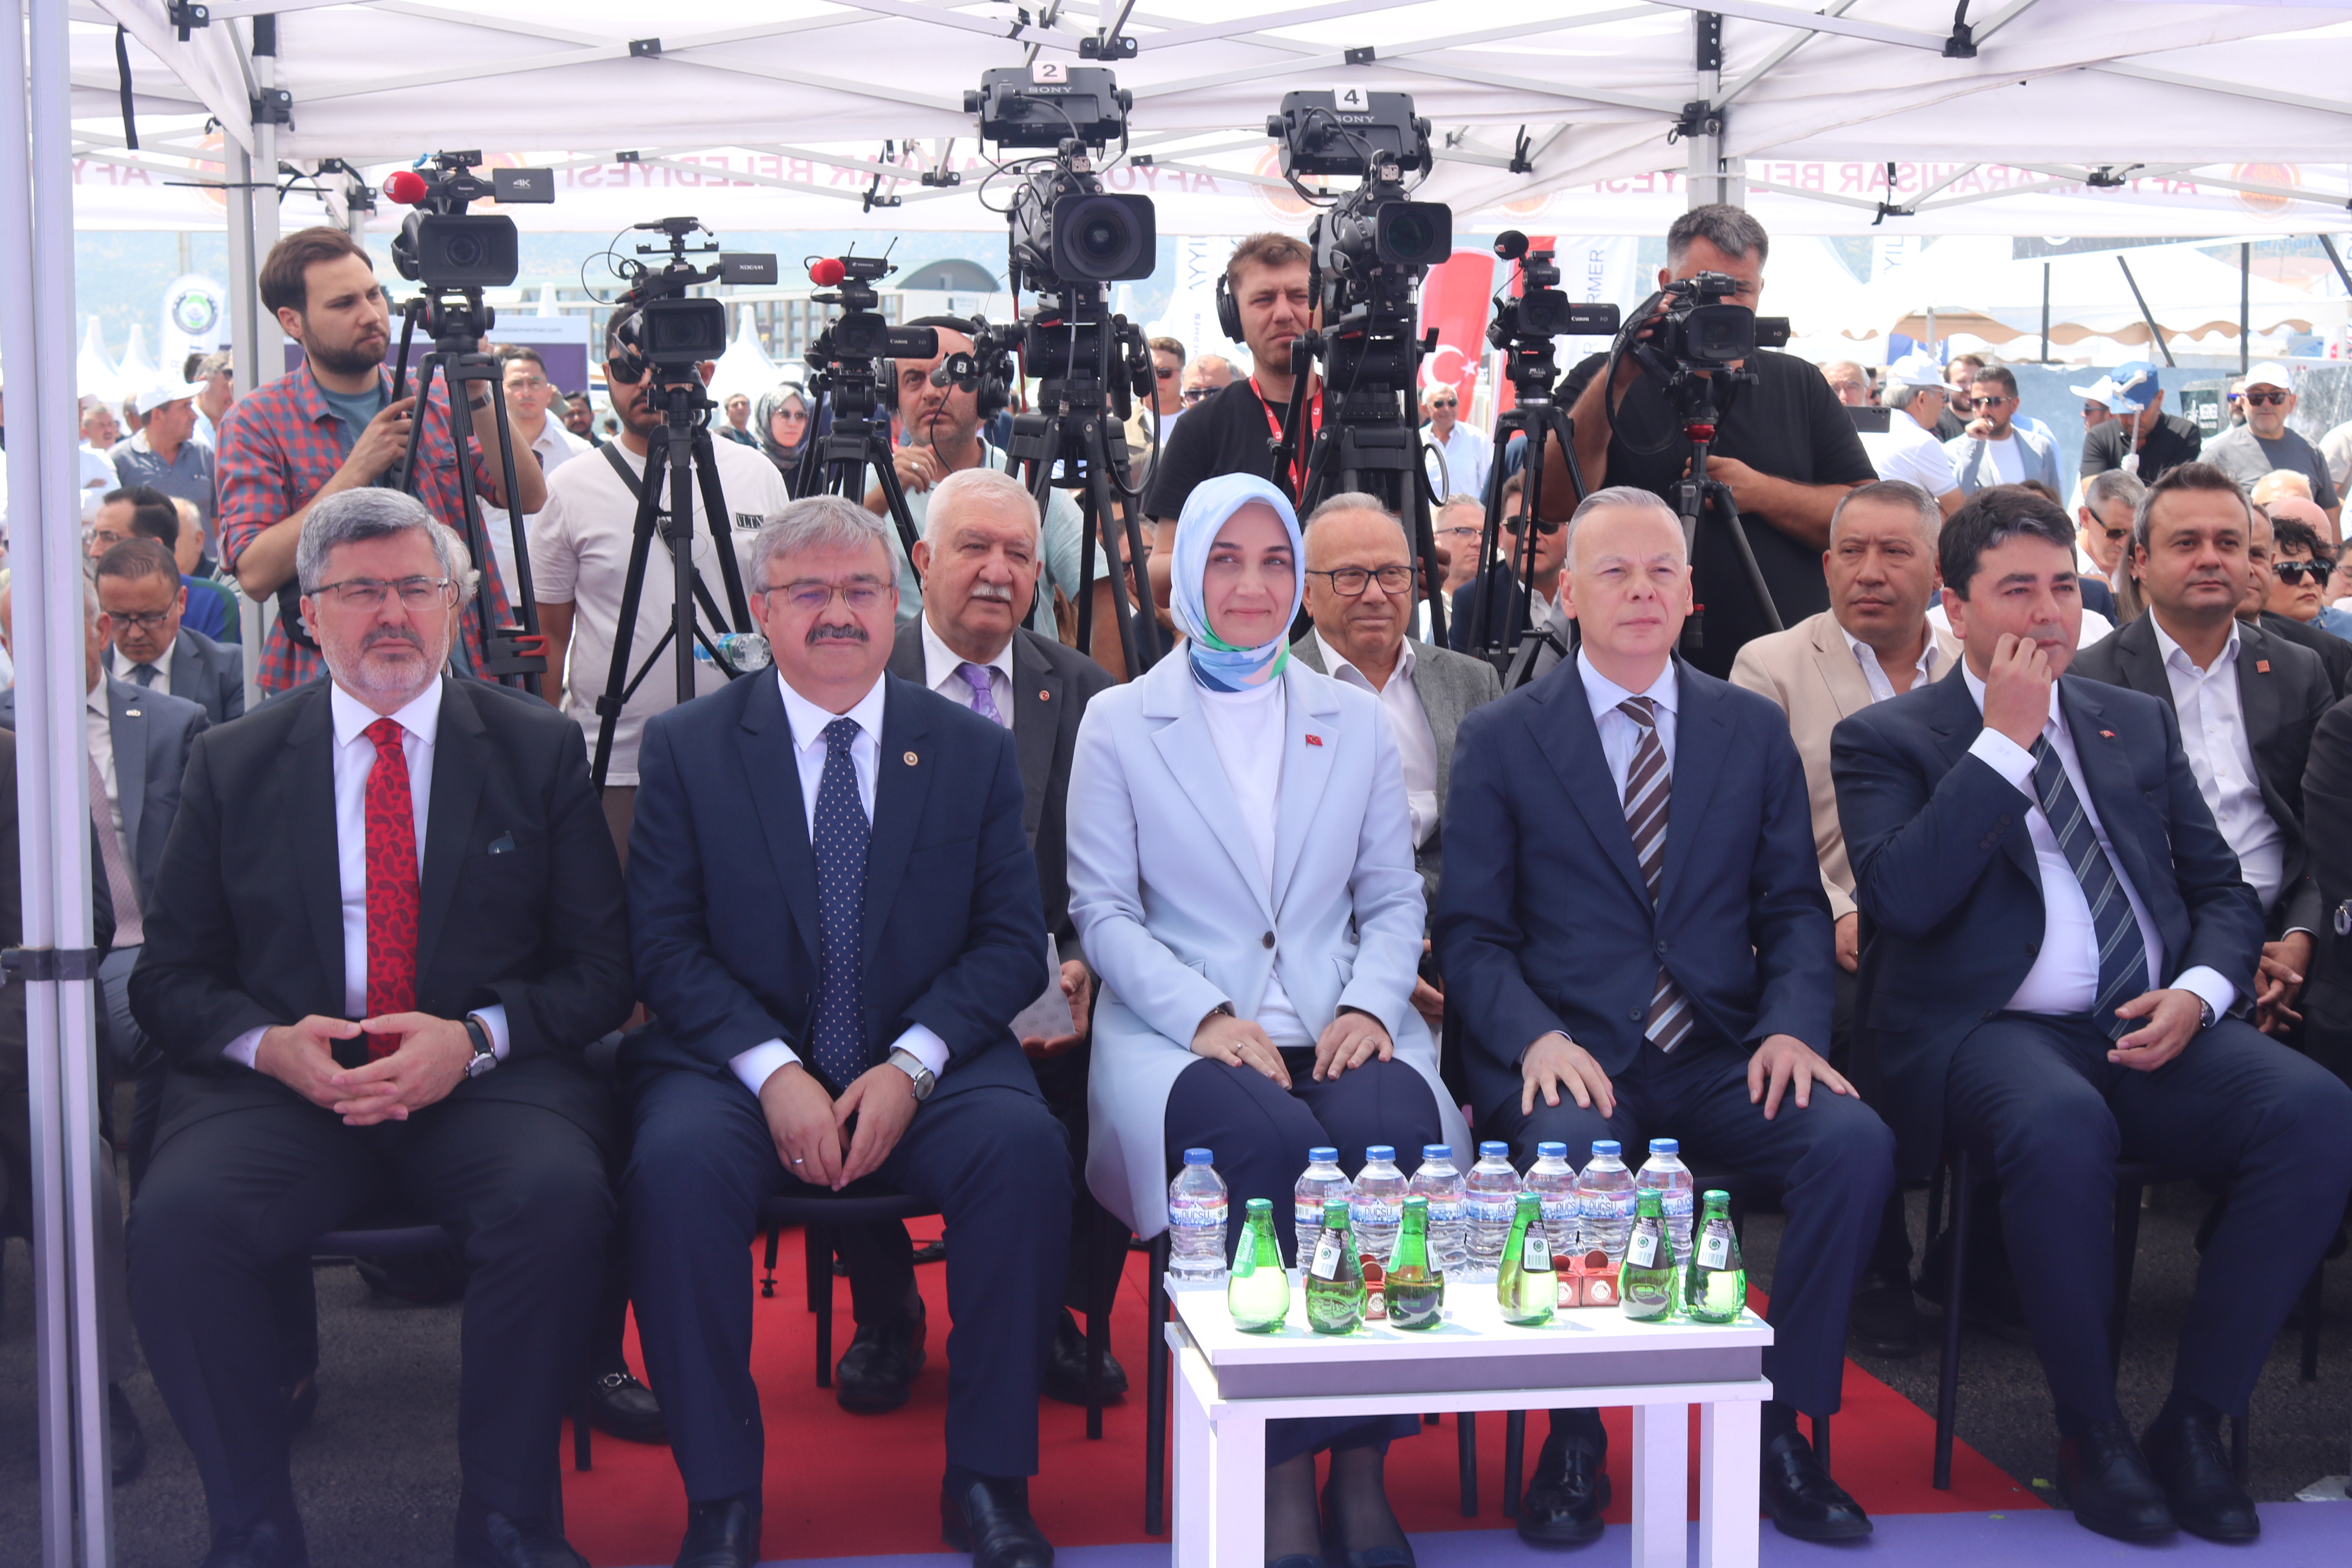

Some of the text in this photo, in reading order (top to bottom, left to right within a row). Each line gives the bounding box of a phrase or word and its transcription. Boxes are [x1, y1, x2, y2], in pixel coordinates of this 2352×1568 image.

[1042, 64, 1058, 77] 2
[1344, 89, 1360, 104] 4
[1334, 115, 1375, 123] SONY
[513, 179, 531, 187] 4K
[1275, 431, 1282, 439] 3
[736, 514, 764, 529] VLTN
